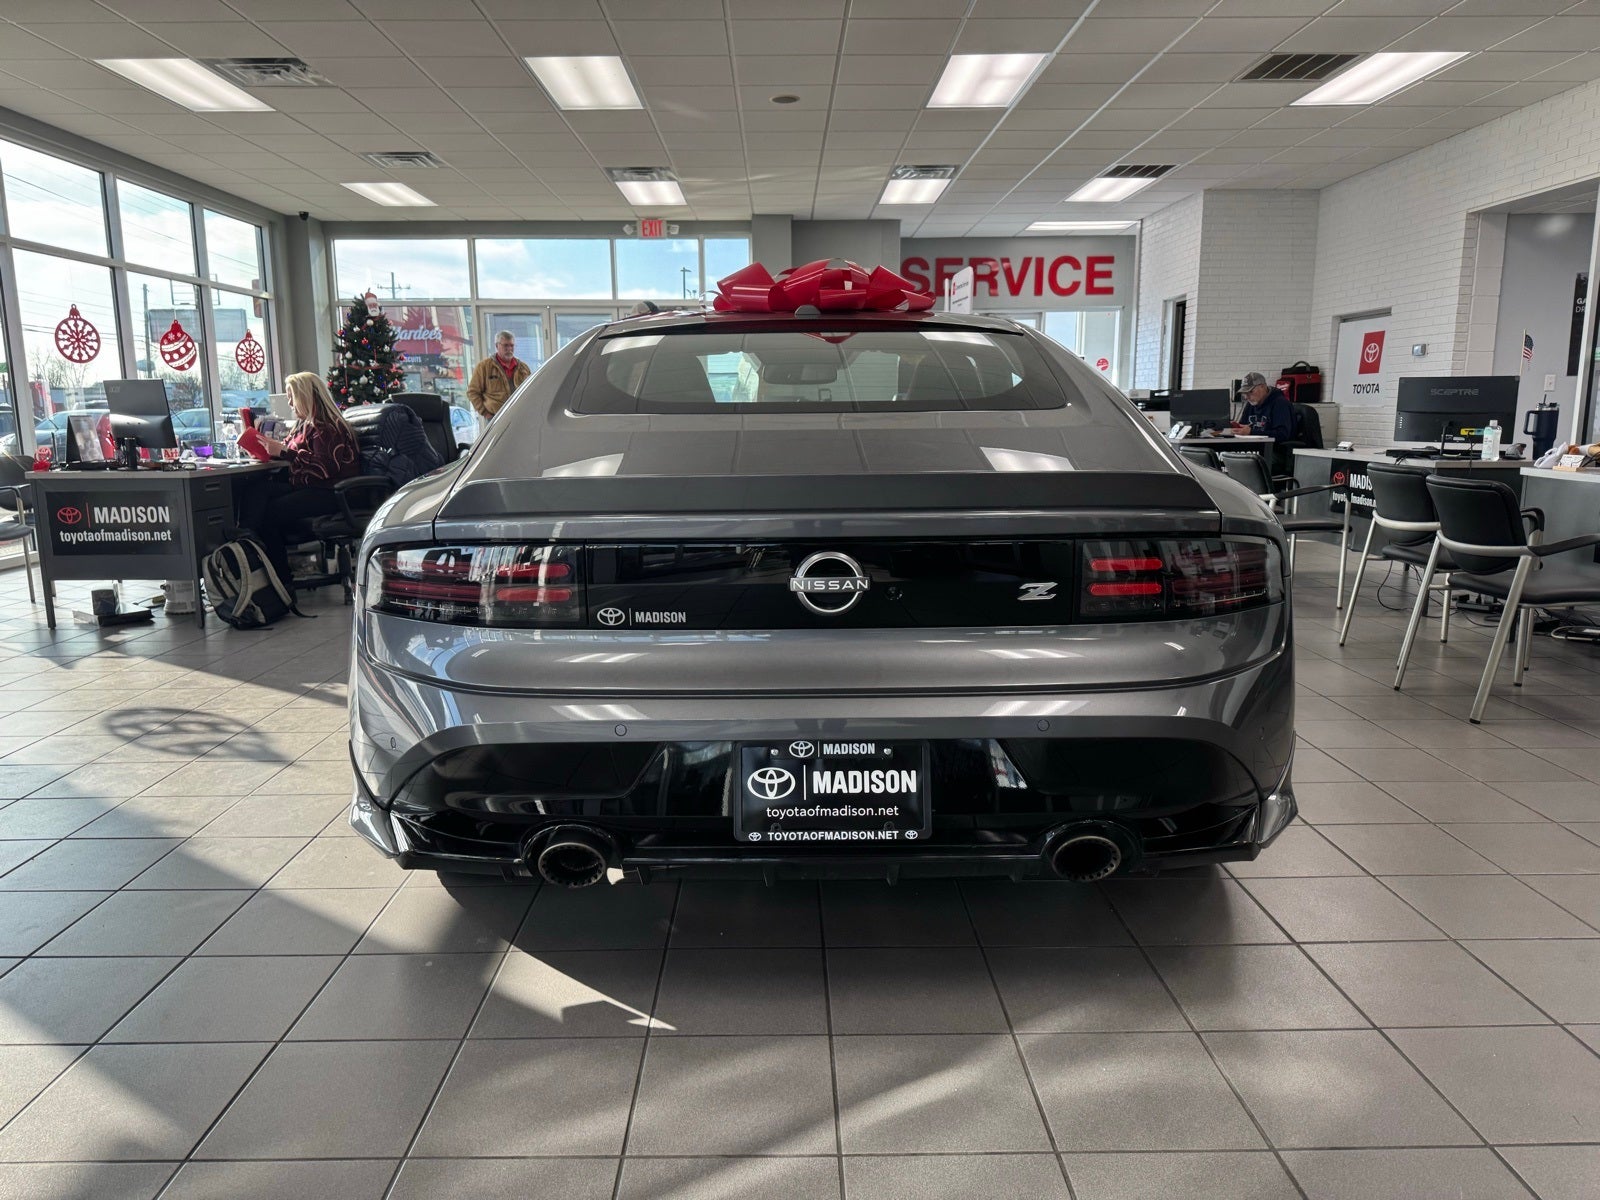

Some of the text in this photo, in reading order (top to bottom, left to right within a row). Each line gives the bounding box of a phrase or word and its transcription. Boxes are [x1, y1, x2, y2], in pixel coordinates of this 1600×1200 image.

[641, 219, 663, 237] EXIT
[900, 254, 1115, 298] SERVICE
[1352, 383, 1380, 394] TOYOTA
[1430, 388, 1479, 396] SCEPTRE
[1349, 473, 1373, 491] MADIS
[93, 506, 170, 524] MADISON
[59, 528, 172, 545] toyotaofmadison.net
[791, 579, 870, 591] NISSAN
[1017, 581, 1059, 601] Z
[634, 611, 687, 624] MADISON
[822, 742, 876, 756] MADISON
[812, 769, 918, 795] MADISON
[766, 804, 900, 820] toyotaofmadison.net
[767, 830, 900, 842] TOYOTAOFMADISON.NET
